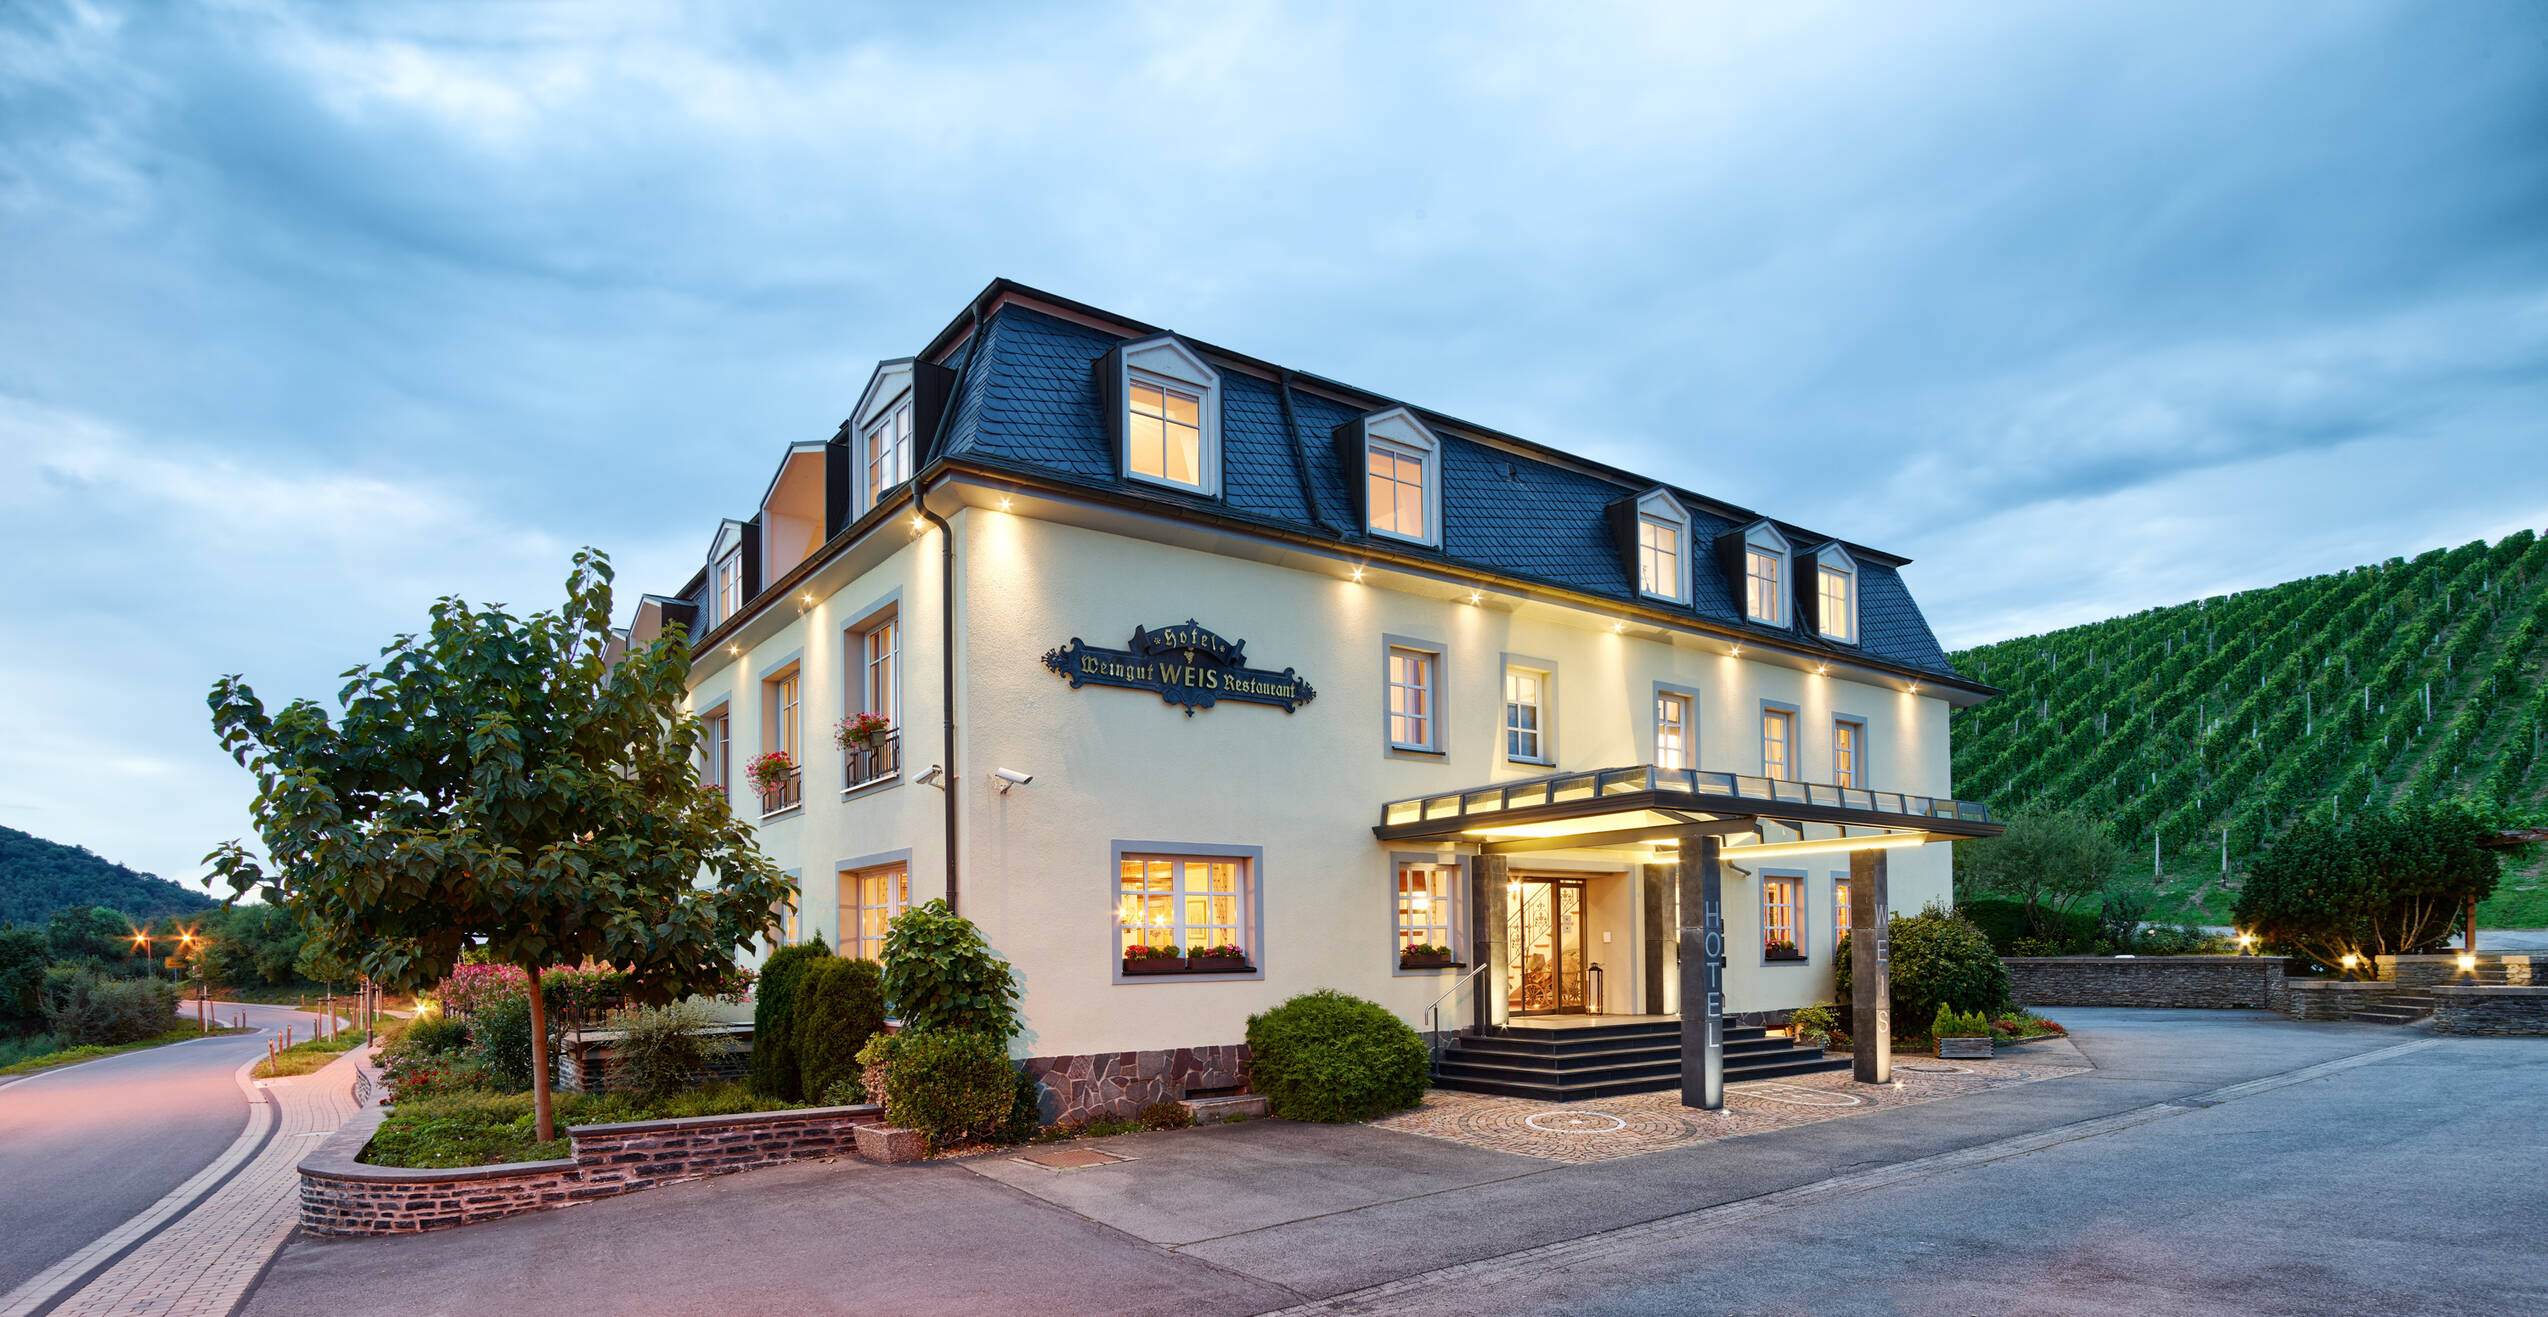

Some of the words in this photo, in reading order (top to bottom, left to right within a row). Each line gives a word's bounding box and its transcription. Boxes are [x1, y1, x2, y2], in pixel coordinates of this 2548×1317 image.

[1081, 655, 1154, 682] Weingut
[1160, 662, 1218, 689] WEIS
[1223, 673, 1296, 698] Restaurant
[1163, 628, 1217, 652] Hotel
[1705, 900, 1721, 1048] HOTEL
[1874, 903, 1889, 1033] WEIS
